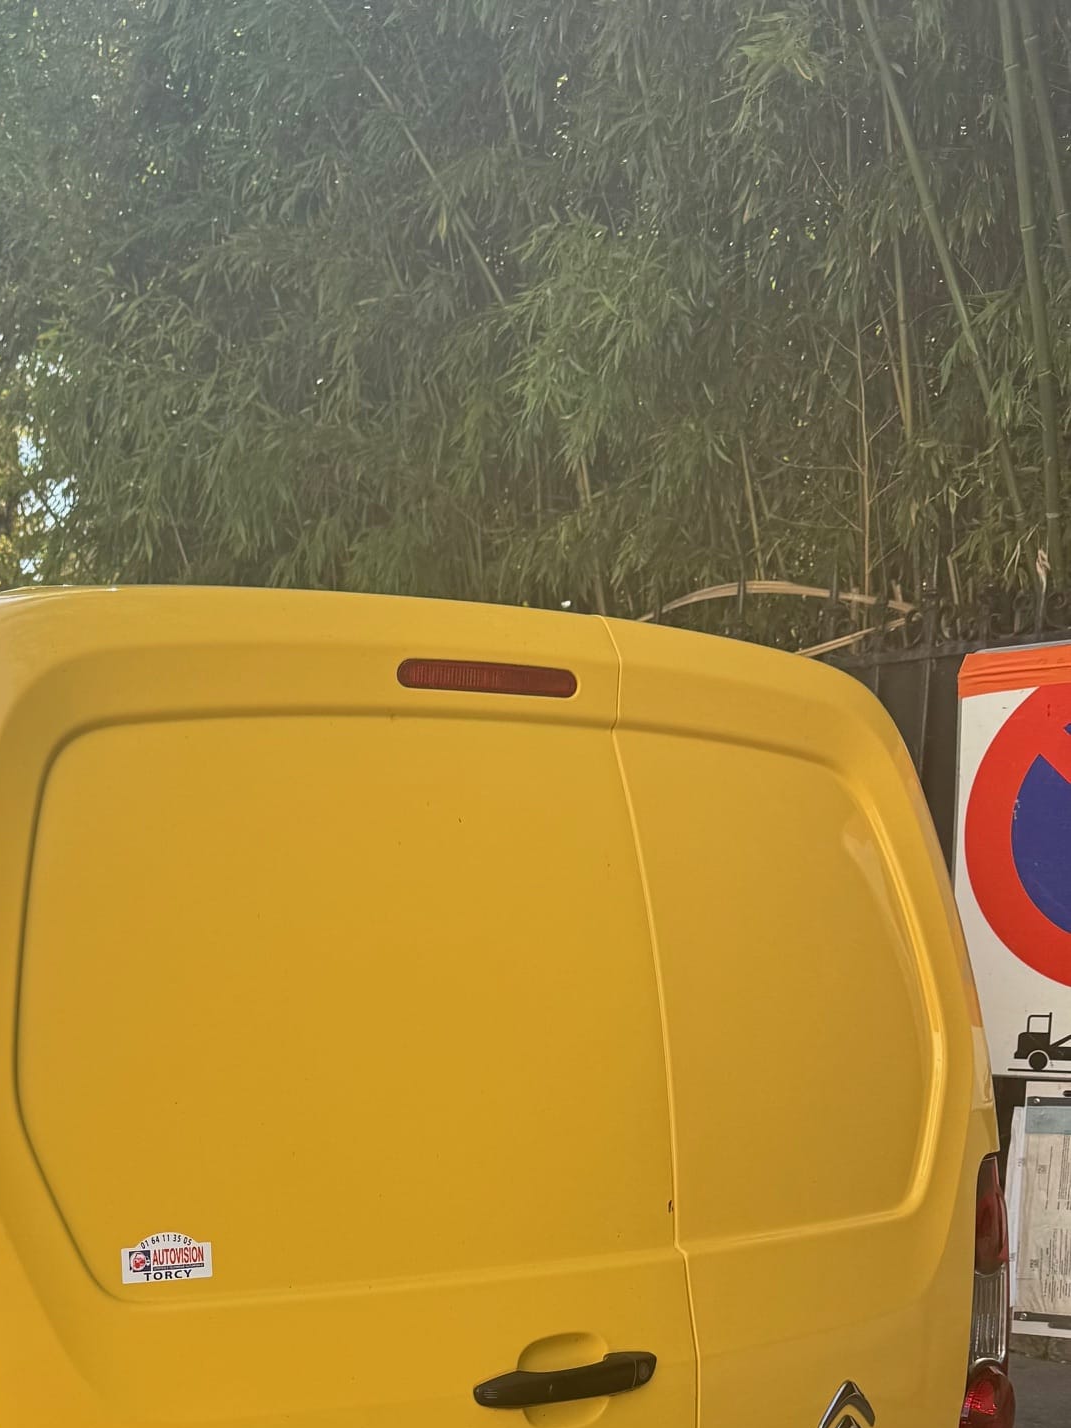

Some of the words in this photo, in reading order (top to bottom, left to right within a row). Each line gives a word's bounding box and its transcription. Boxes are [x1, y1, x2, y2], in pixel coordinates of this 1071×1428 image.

[141, 1240, 149, 1249] 01
[151, 1236, 160, 1245] 64
[173, 1234, 181, 1243] 35
[183, 1236, 192, 1246] 05
[152, 1246, 204, 1266] AUTOVISION
[143, 1269, 192, 1281] TORCY
